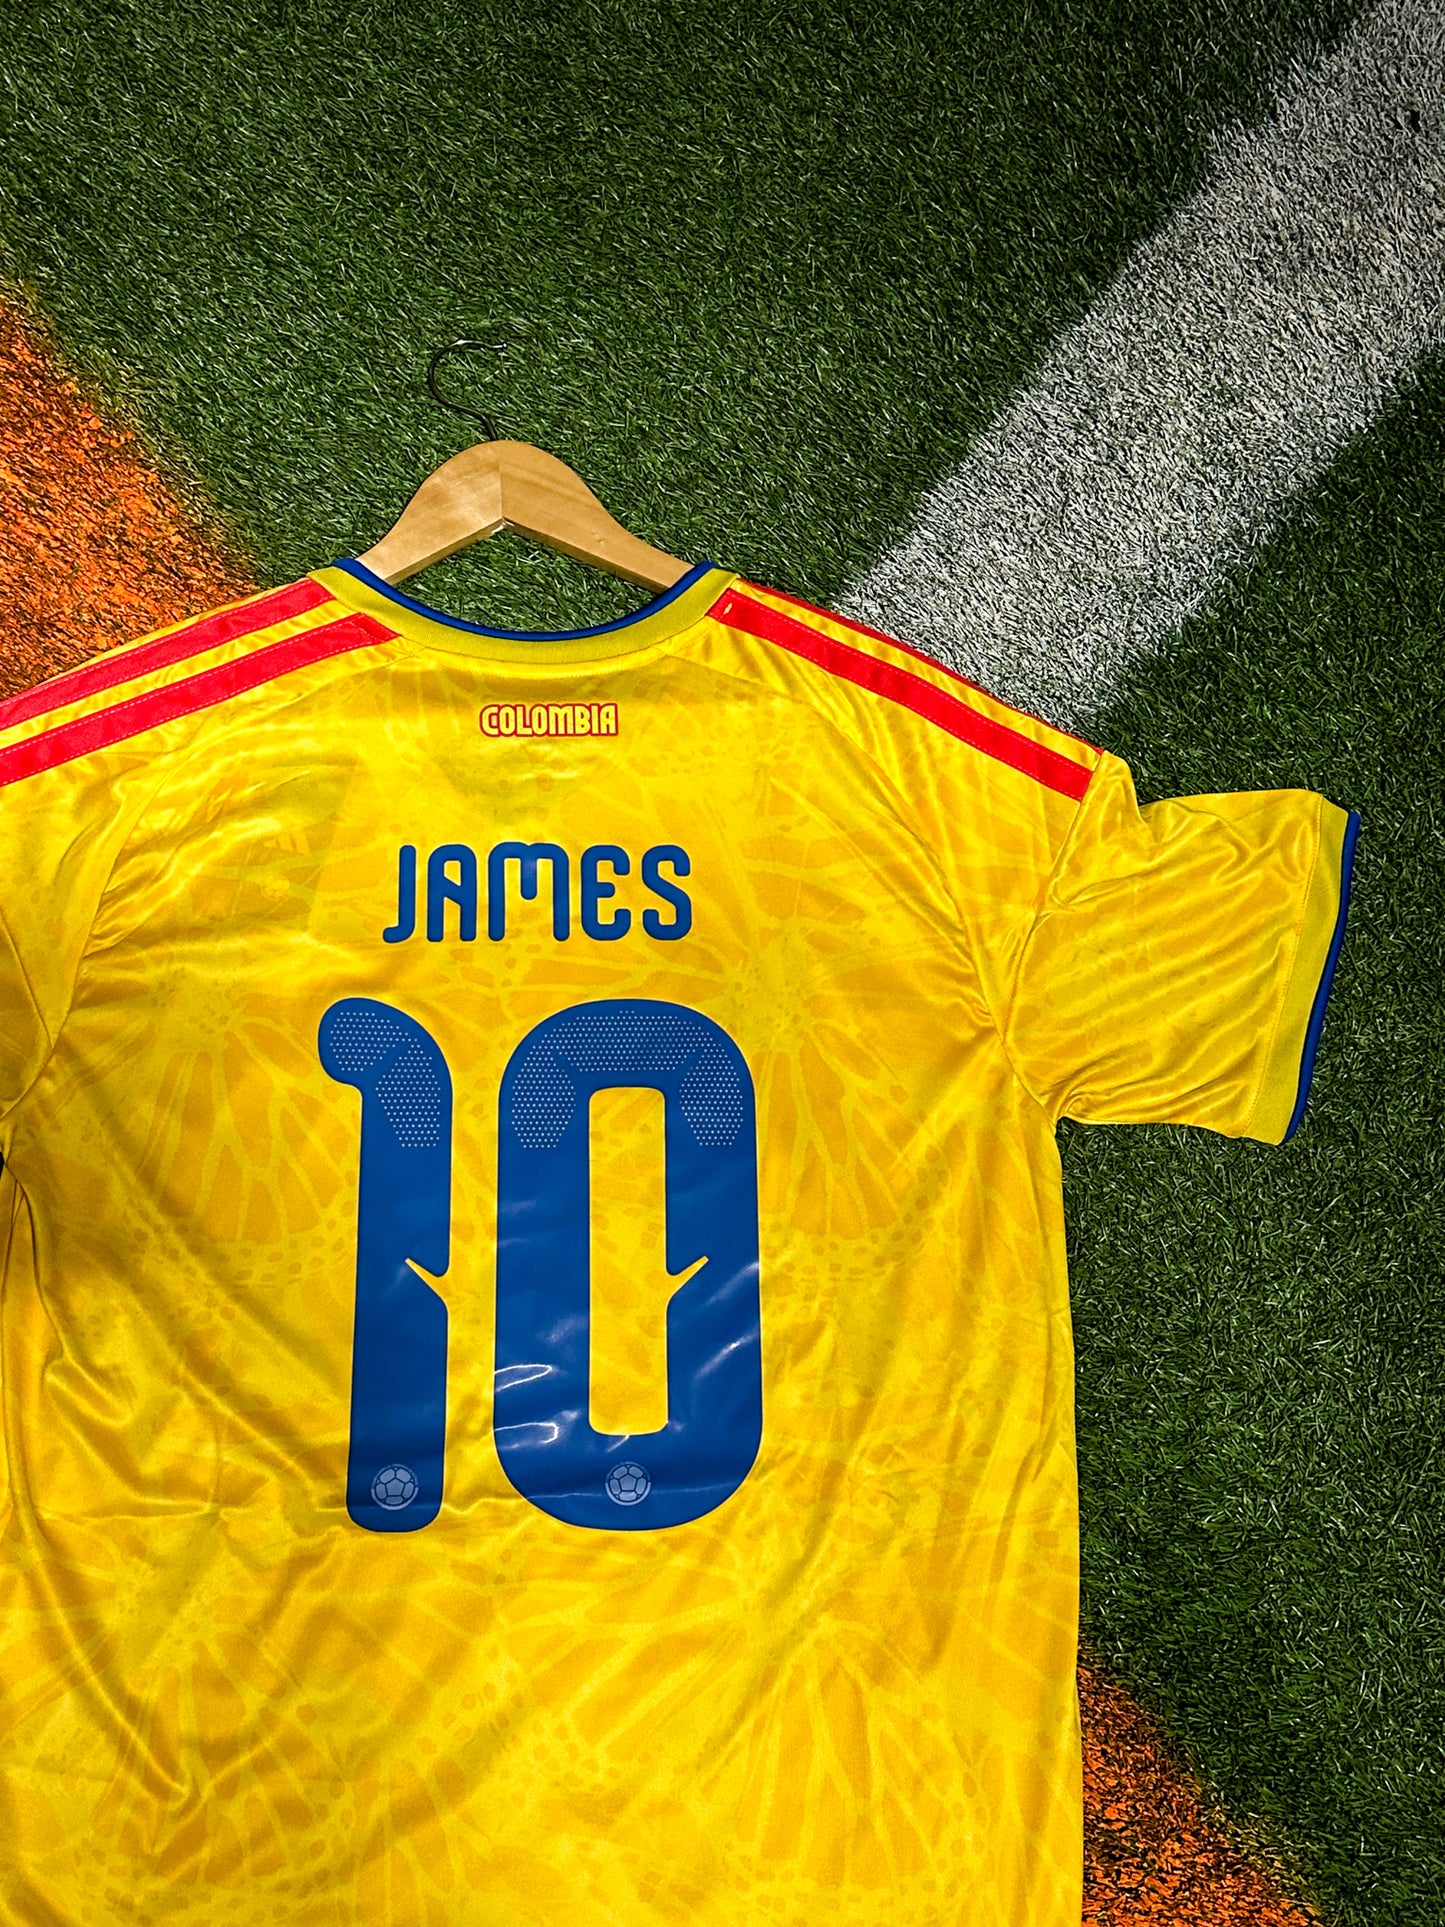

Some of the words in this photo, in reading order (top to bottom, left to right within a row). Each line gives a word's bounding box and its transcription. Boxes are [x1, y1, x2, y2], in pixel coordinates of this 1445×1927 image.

[480, 703, 619, 737] COLOMBIA
[383, 842, 692, 943] JAMES
[318, 997, 763, 1532] 10
